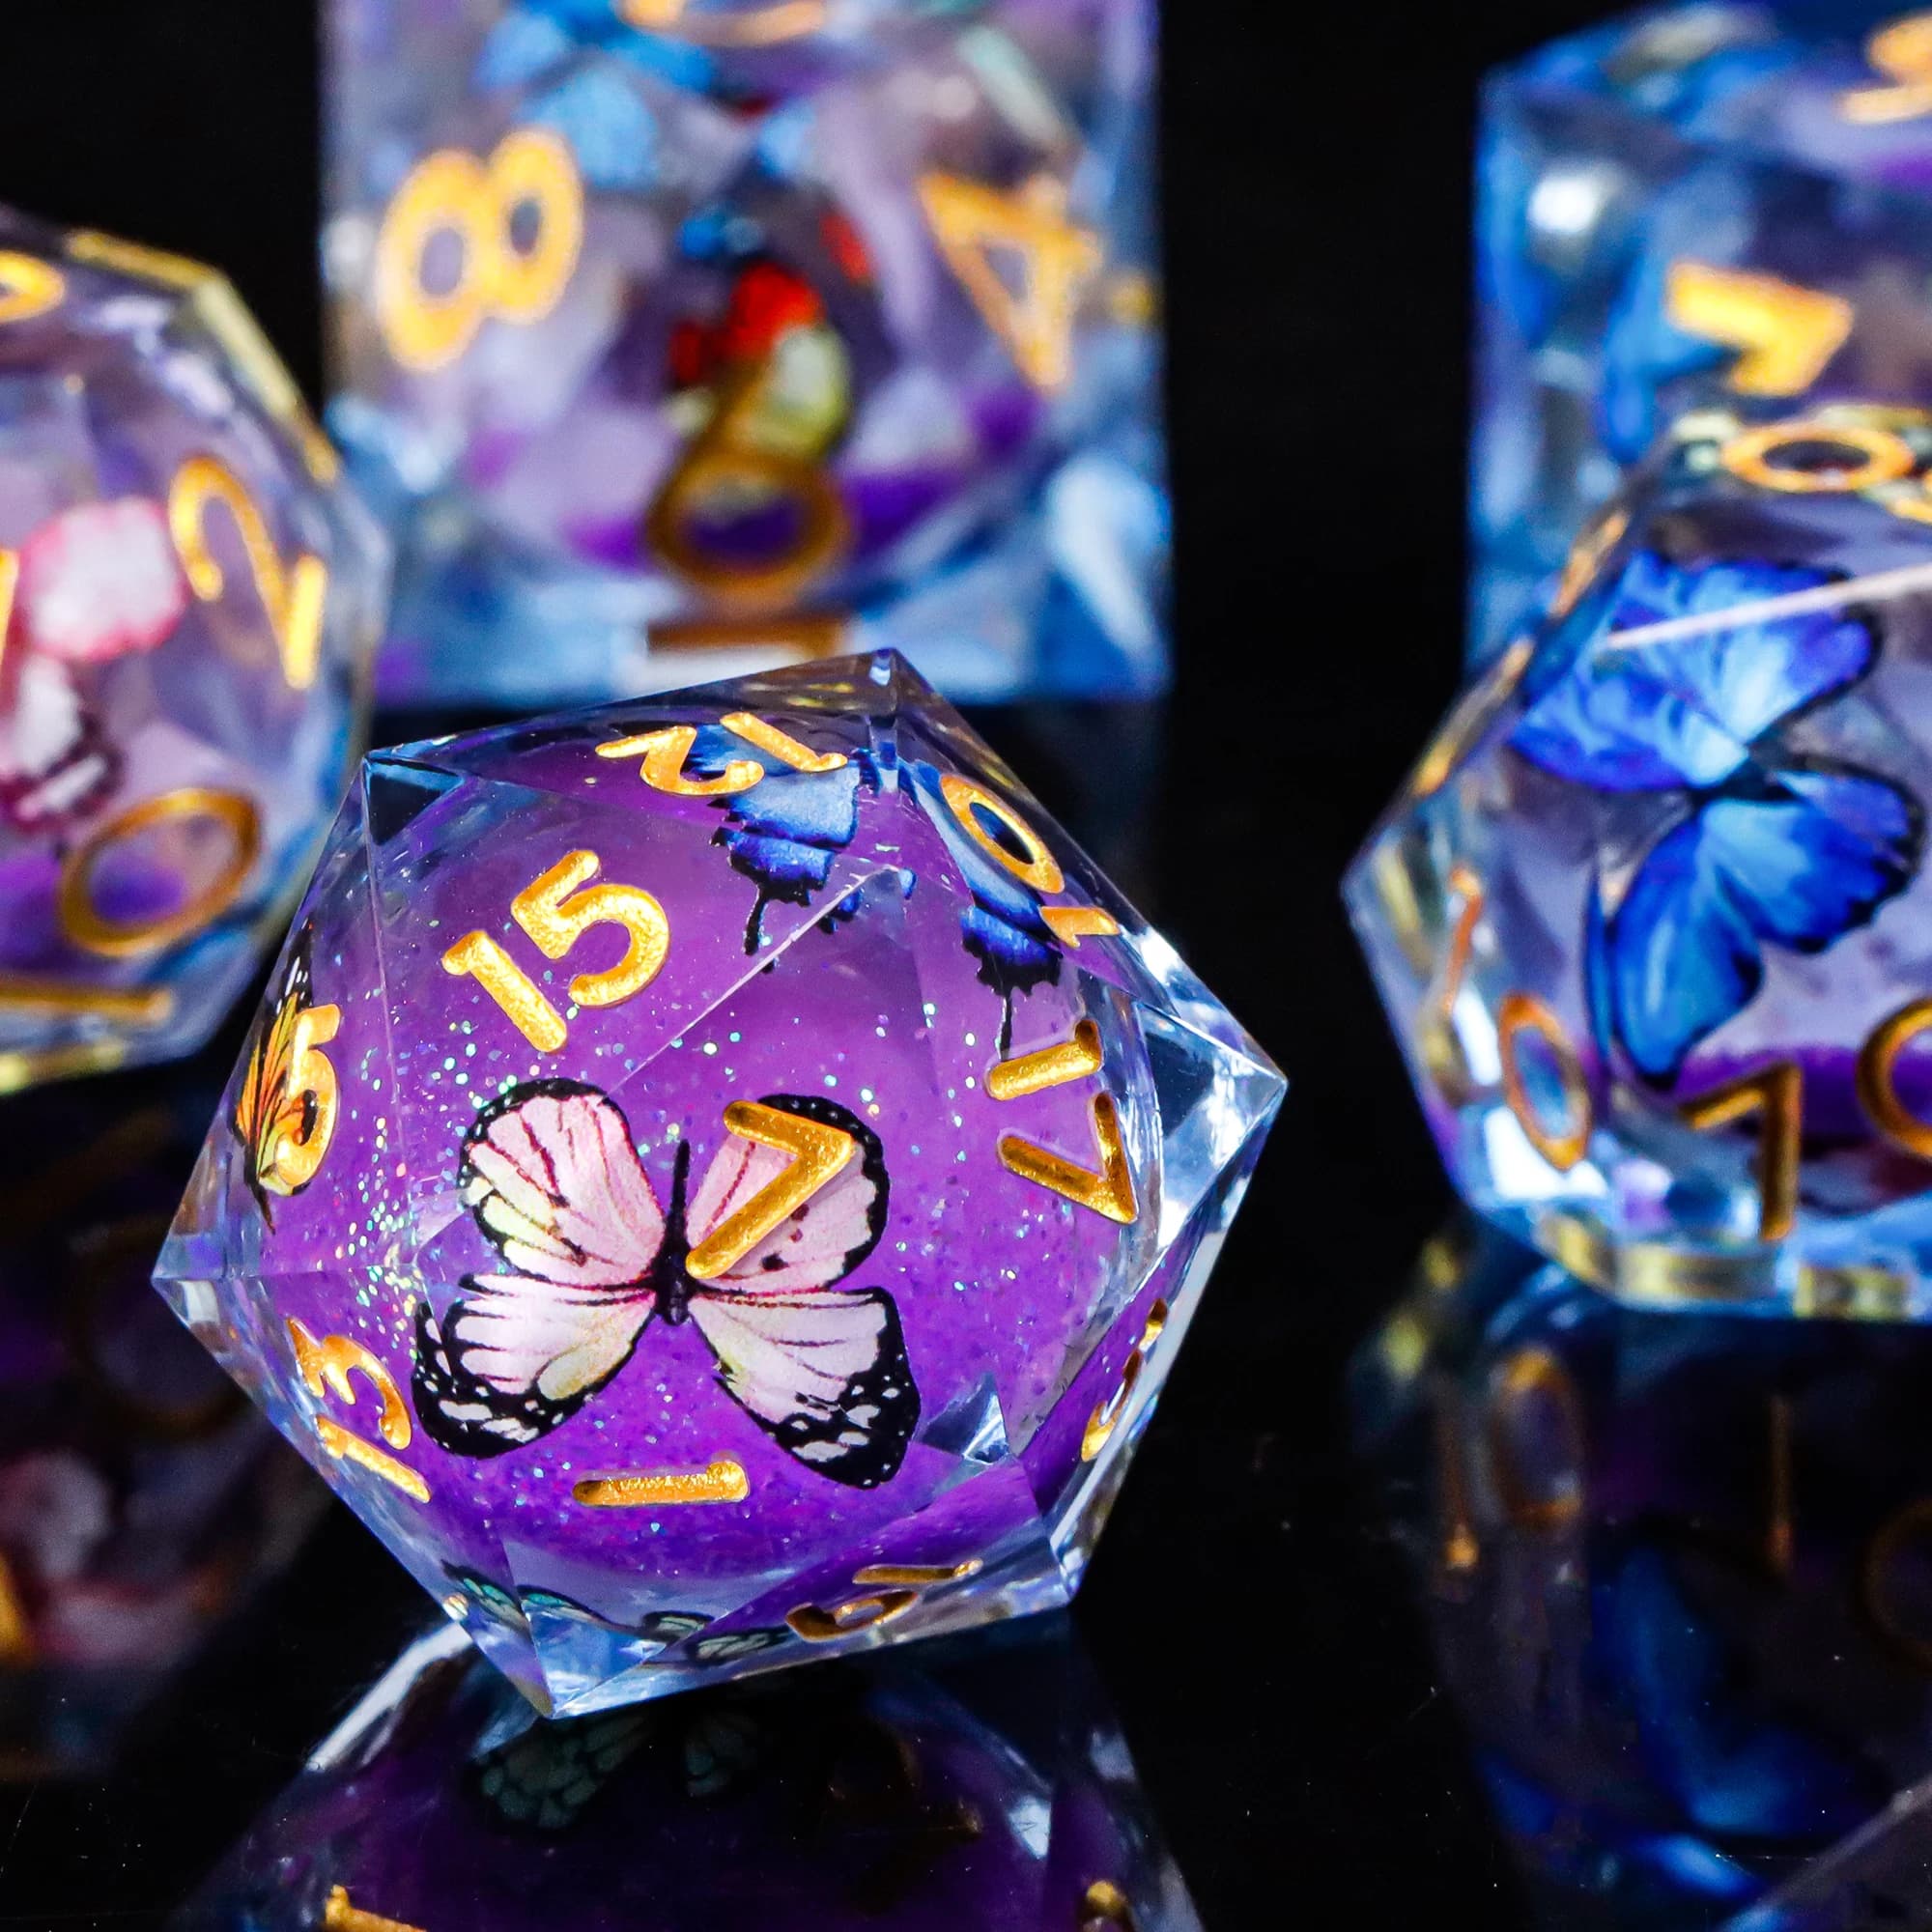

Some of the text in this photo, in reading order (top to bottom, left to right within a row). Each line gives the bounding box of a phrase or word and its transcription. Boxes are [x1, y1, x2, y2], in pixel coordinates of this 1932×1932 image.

[168, 454, 328, 689] 2
[595, 712, 848, 796] 12
[441, 850, 669, 1052] 15
[942, 775, 1119, 947] 10
[685, 1099, 854, 1280] 7
[985, 1019, 1138, 1225] 17
[287, 1317, 432, 1503] 13
[572, 1460, 750, 1507] 1
